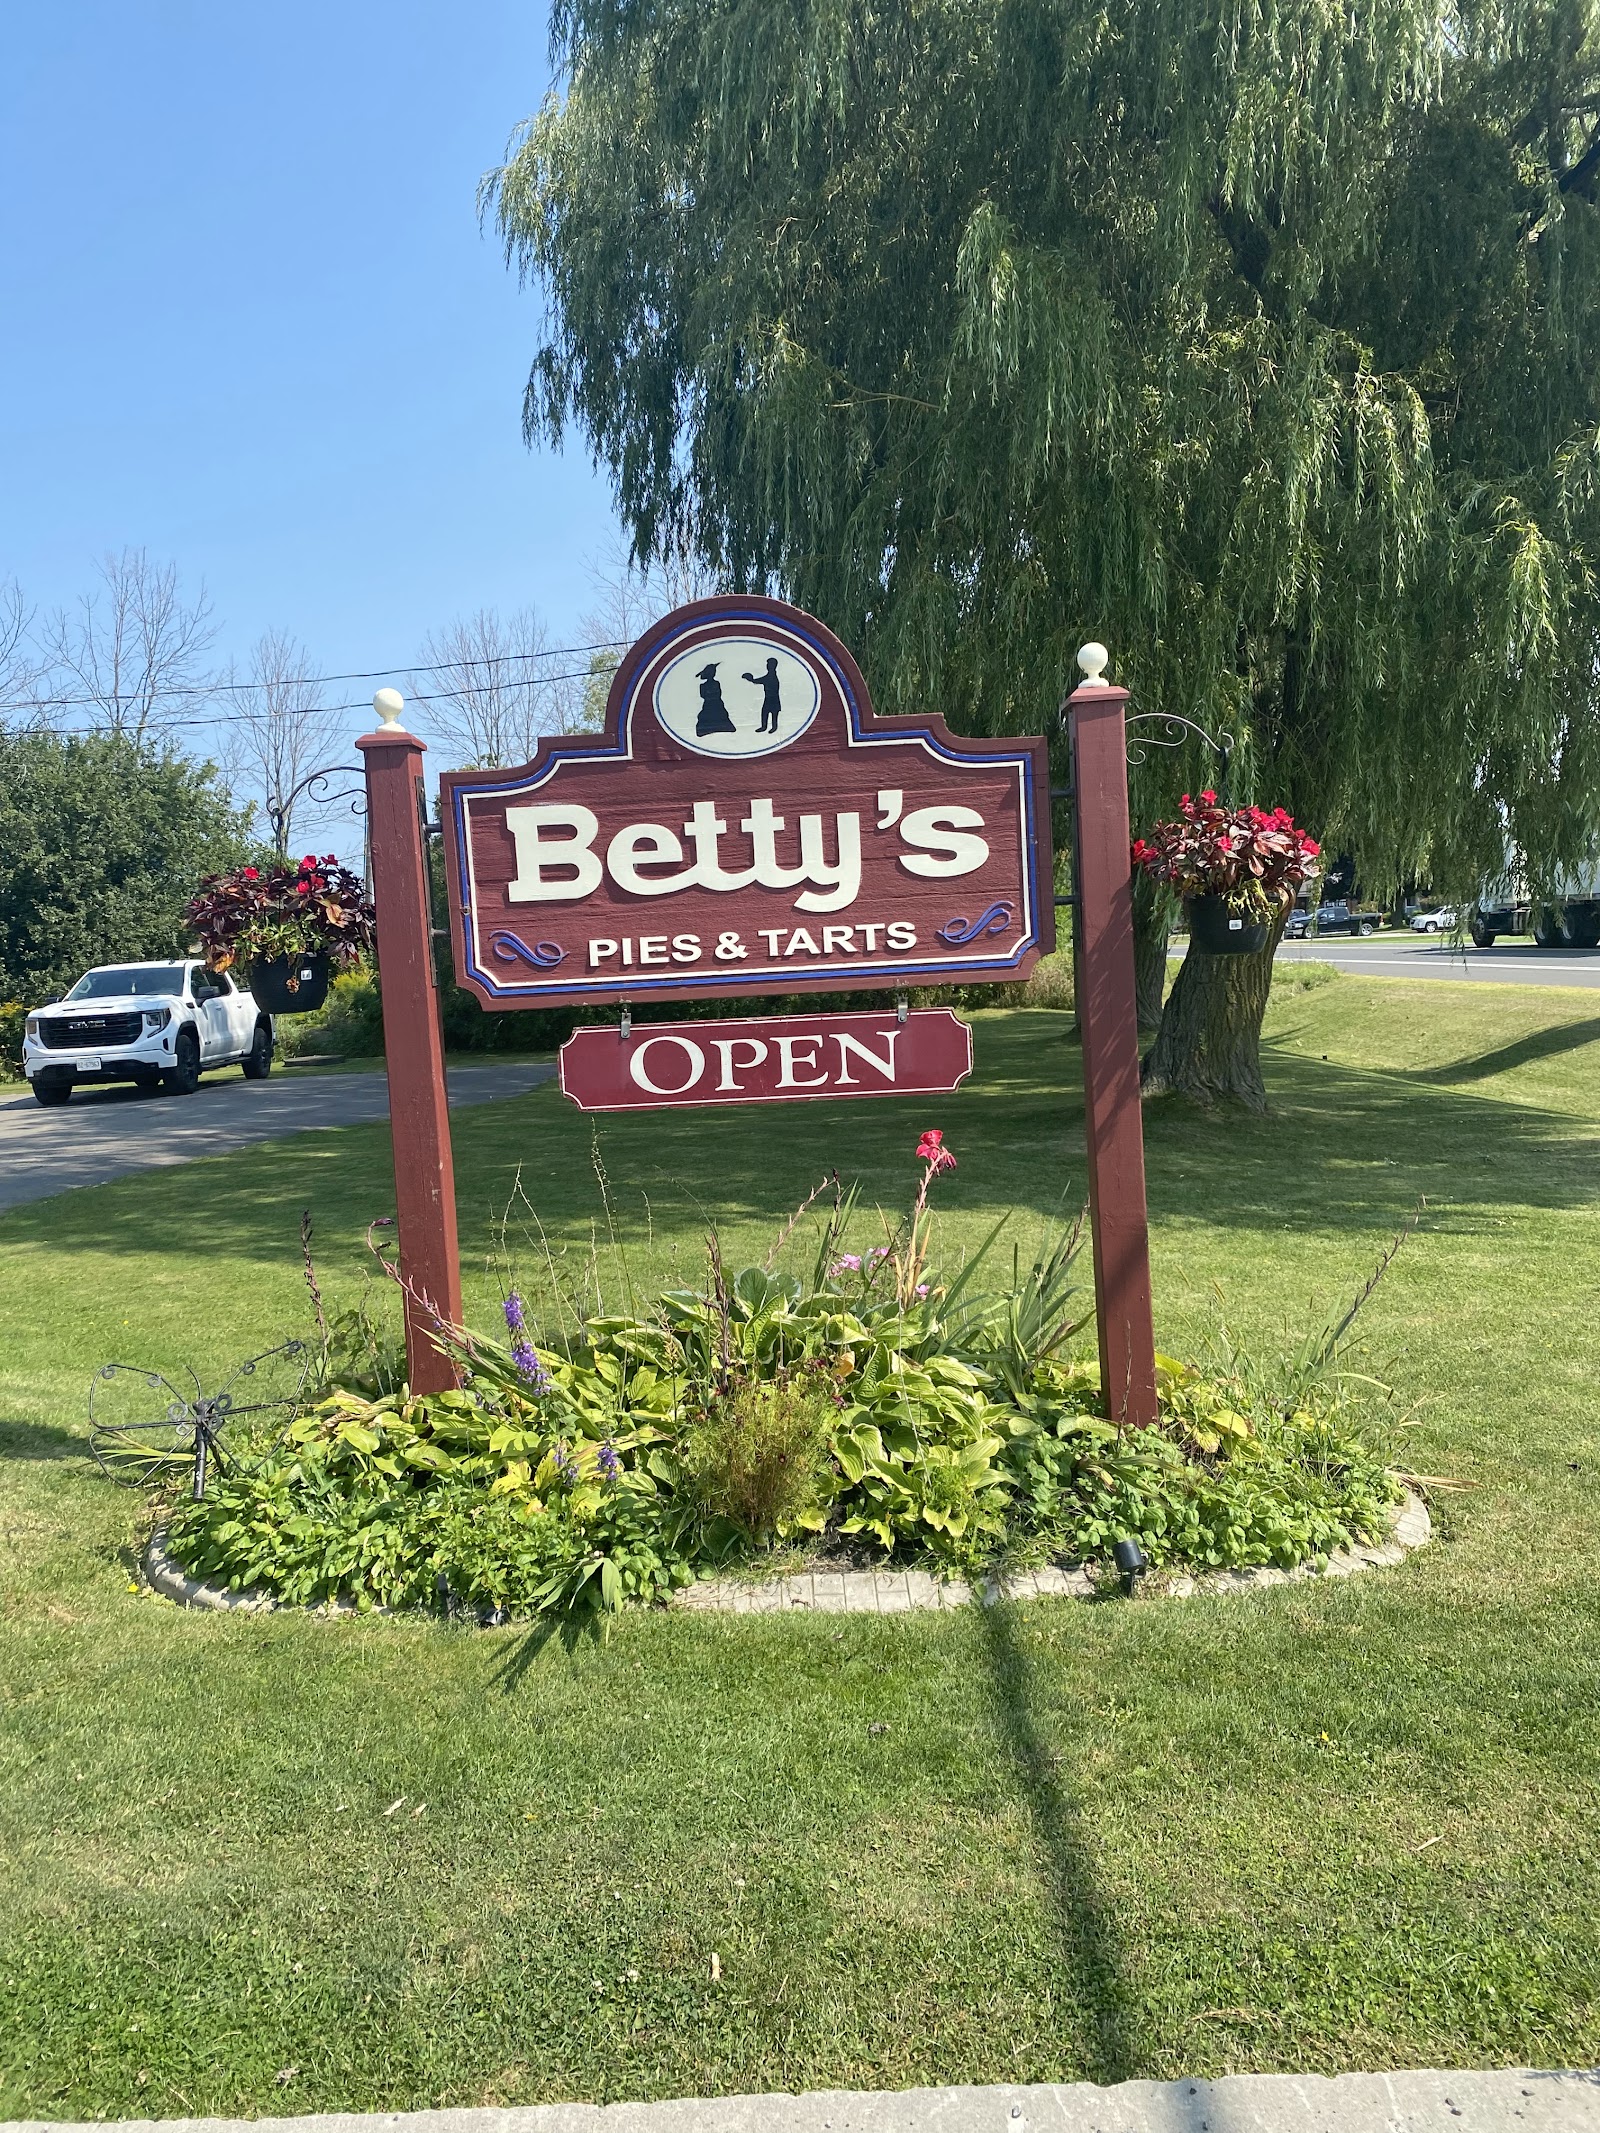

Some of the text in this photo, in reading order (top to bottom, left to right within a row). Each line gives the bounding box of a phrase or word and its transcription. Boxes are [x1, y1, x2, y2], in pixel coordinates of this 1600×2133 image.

[505, 789, 990, 913] Betty's
[588, 922, 918, 967] PIES & TARTS
[630, 1031, 902, 1096] OPEN
